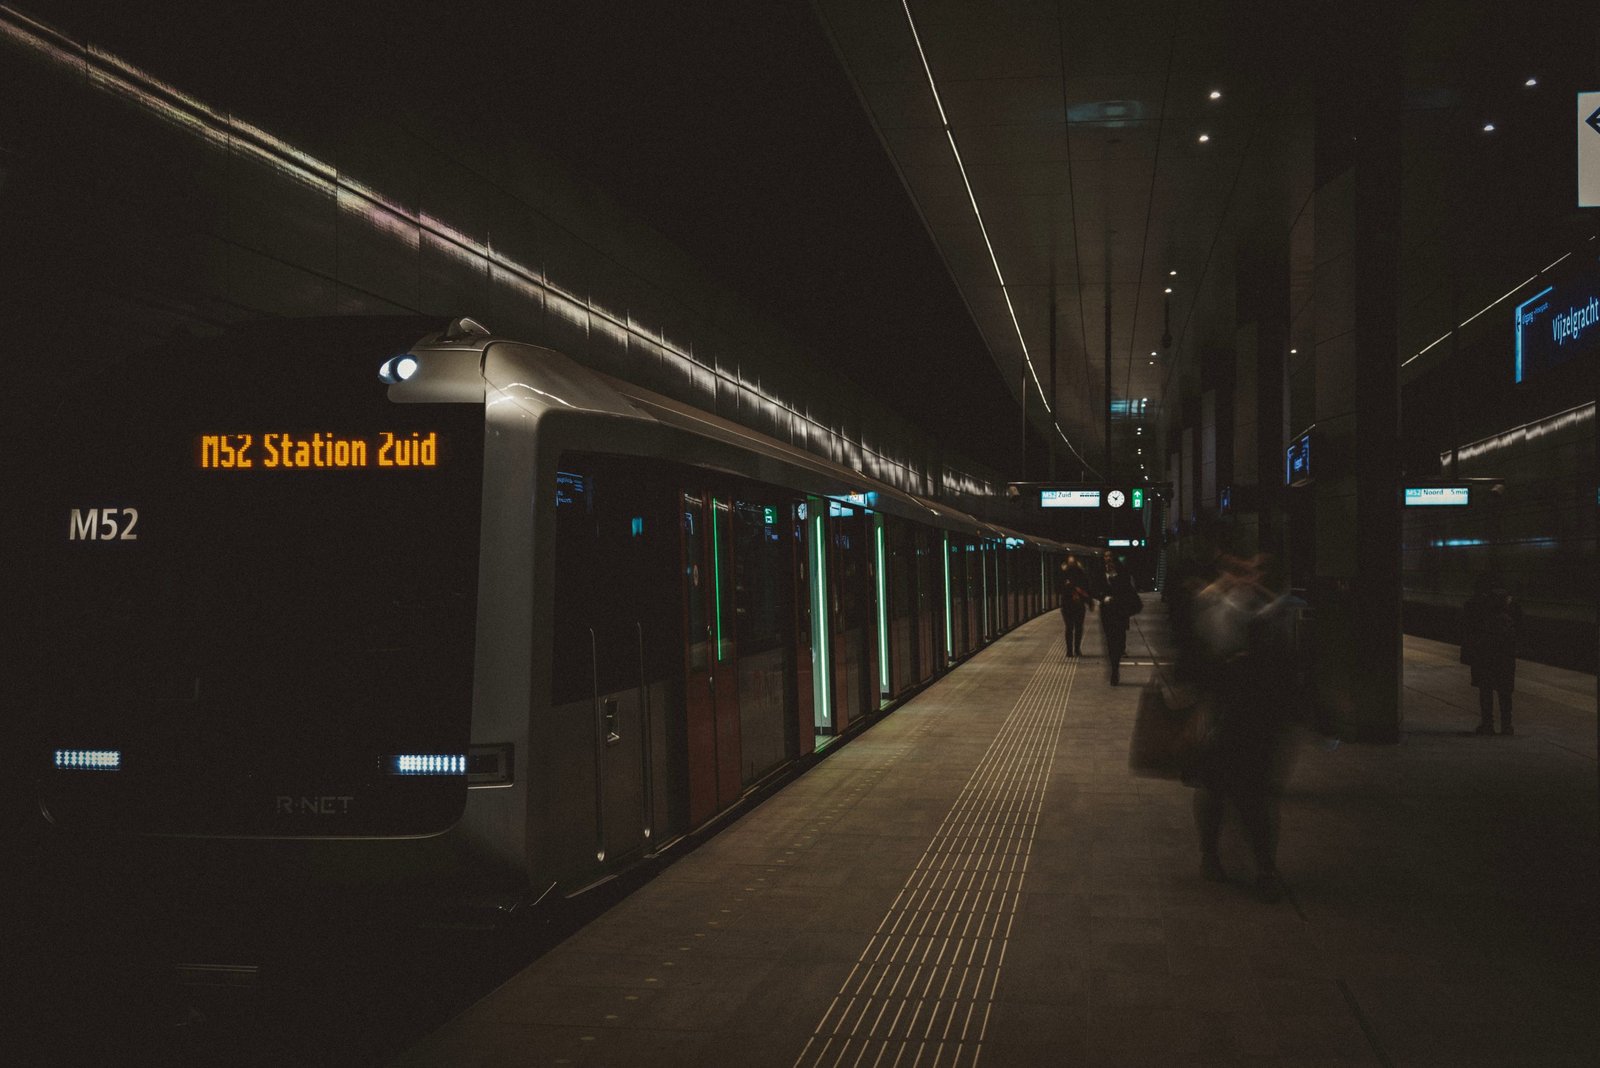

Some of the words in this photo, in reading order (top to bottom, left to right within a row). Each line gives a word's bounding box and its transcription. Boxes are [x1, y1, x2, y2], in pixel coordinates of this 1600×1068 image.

[1552, 296, 1600, 346] Vijzelgracht
[201, 434, 253, 468] M52
[263, 432, 367, 468] Station
[378, 431, 437, 467] Zuid
[69, 507, 138, 541] M52
